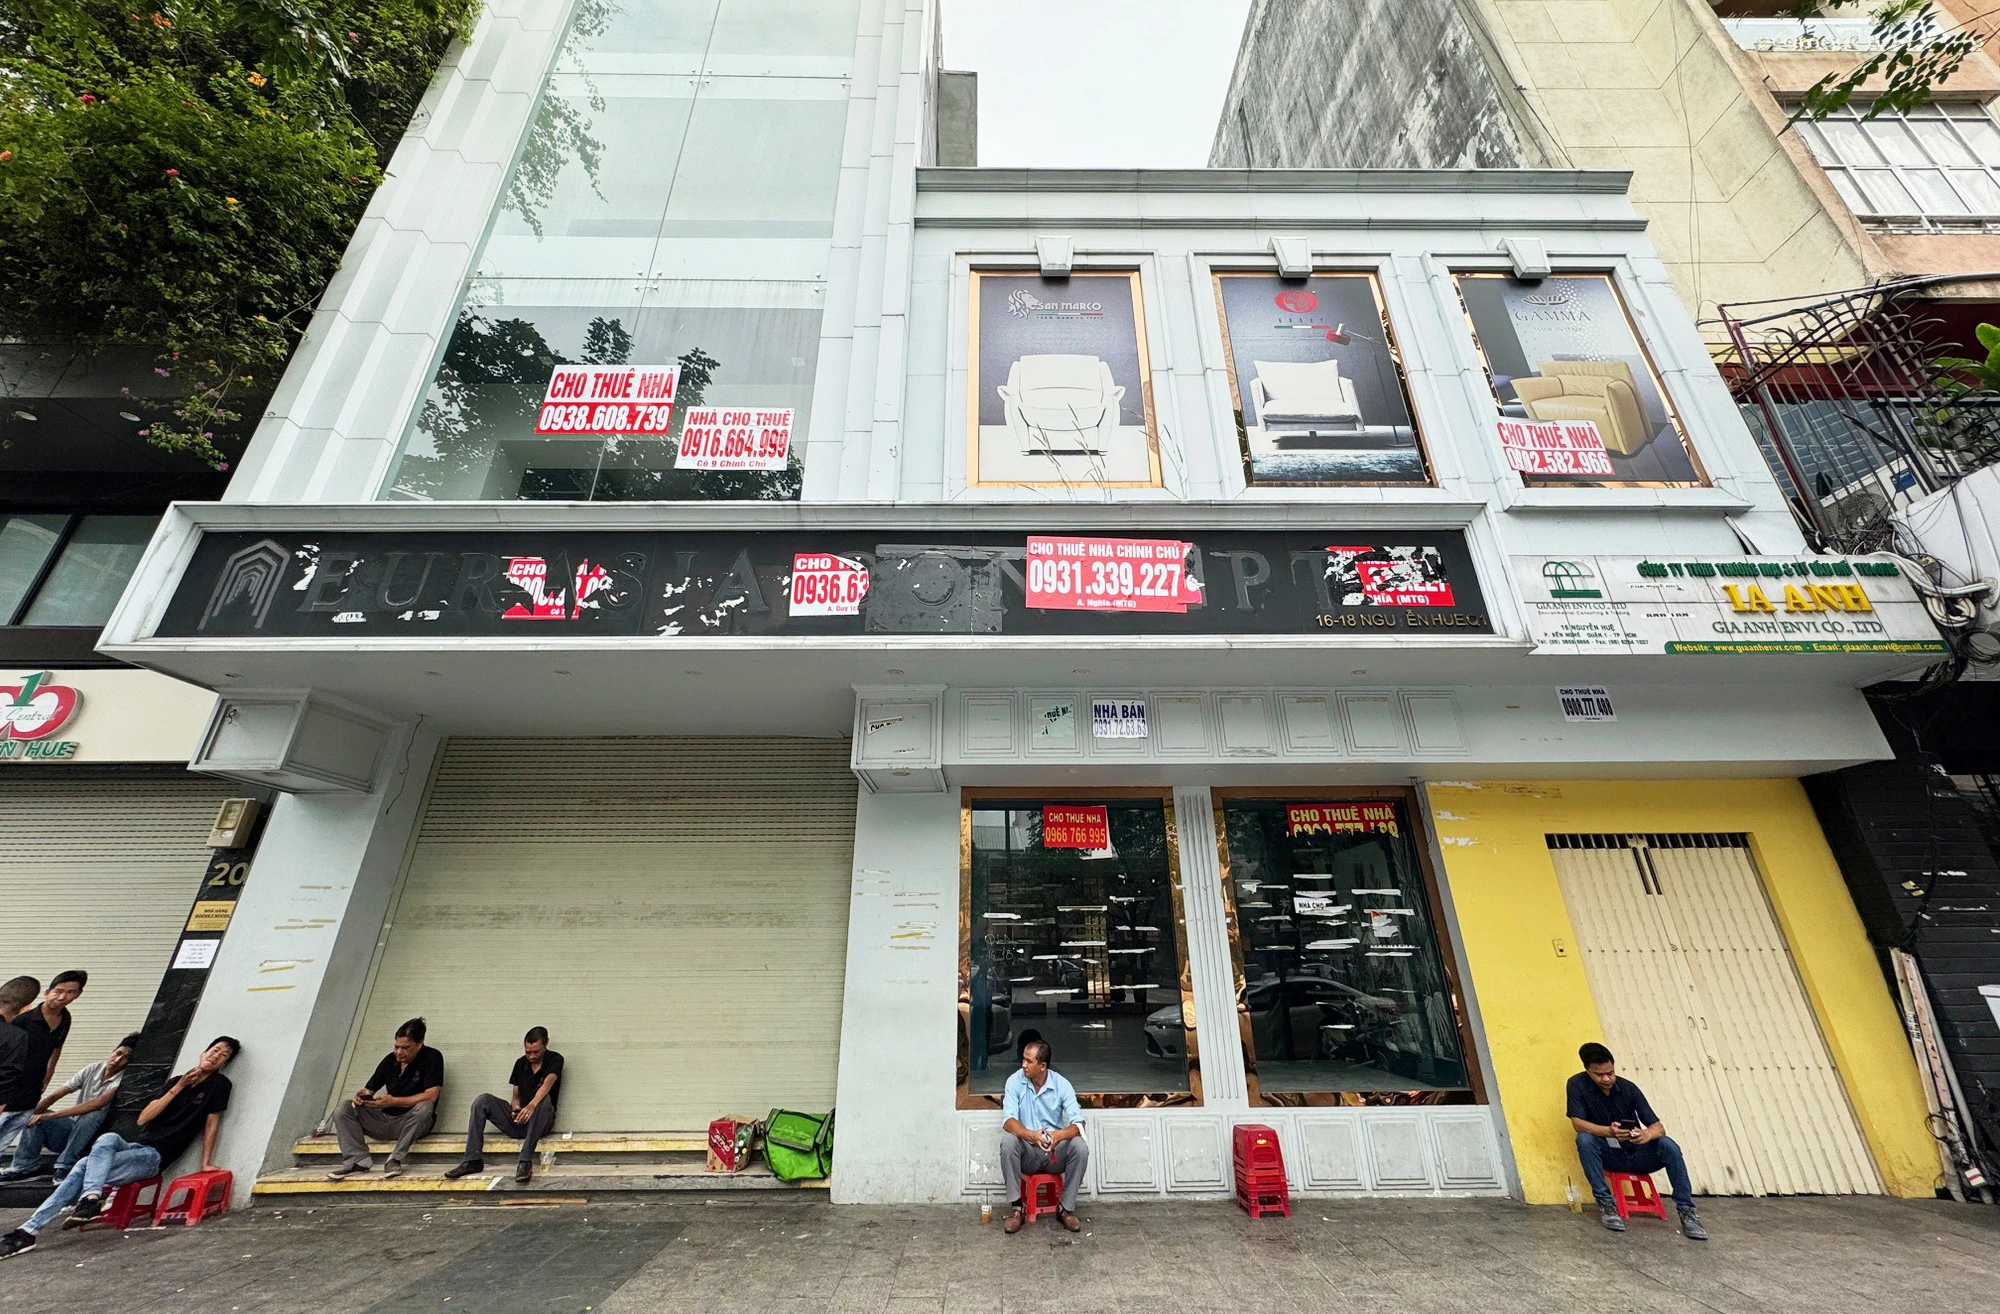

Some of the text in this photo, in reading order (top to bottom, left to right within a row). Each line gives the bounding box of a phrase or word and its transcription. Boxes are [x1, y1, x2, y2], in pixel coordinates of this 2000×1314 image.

[1061, 302, 1102, 310] MARCO
[1514, 310, 1592, 321] GAMMA
[550, 367, 674, 399] CHO THUÊ NHÀ
[539, 404, 671, 431] 0938.608.739
[688, 409, 791, 426] NHÀ CHO THUÊ
[681, 427, 789, 458] 0916.664.999
[1496, 421, 1603, 449] CHO THUÊ NHÀ
[1504, 447, 1614, 474] 0902.582.966
[1030, 541, 1180, 560] CHO THUÊ NHÀ CHÍNH CHỦ
[511, 563, 547, 576] CHO
[796, 557, 832, 570] CHO
[1029, 559, 1181, 597] 0931.339.227
[1077, 598, 1085, 606] A.
[1112, 599, 1137, 608] (MTG)
[1396, 594, 1430, 606] (MTG)
[1784, 583, 1876, 613] ANH
[1315, 613, 1357, 628] 16-18
[1780, 621, 1820, 634] ENVI
[1673, 643, 1712, 652] Website:
[1812, 643, 1841, 652] Email:
[1573, 687, 1591, 695] THUÊ
[1093, 701, 1118, 719] NHÀ
[1121, 701, 1145, 719] BÁN
[24, 741, 72, 757] HUE
[1048, 812, 1065, 823] CHO
[1290, 804, 1396, 822] CHO THUÊ NHÀ
[1045, 826, 1106, 844] 0966 766 995
[207, 861, 251, 887] 20
